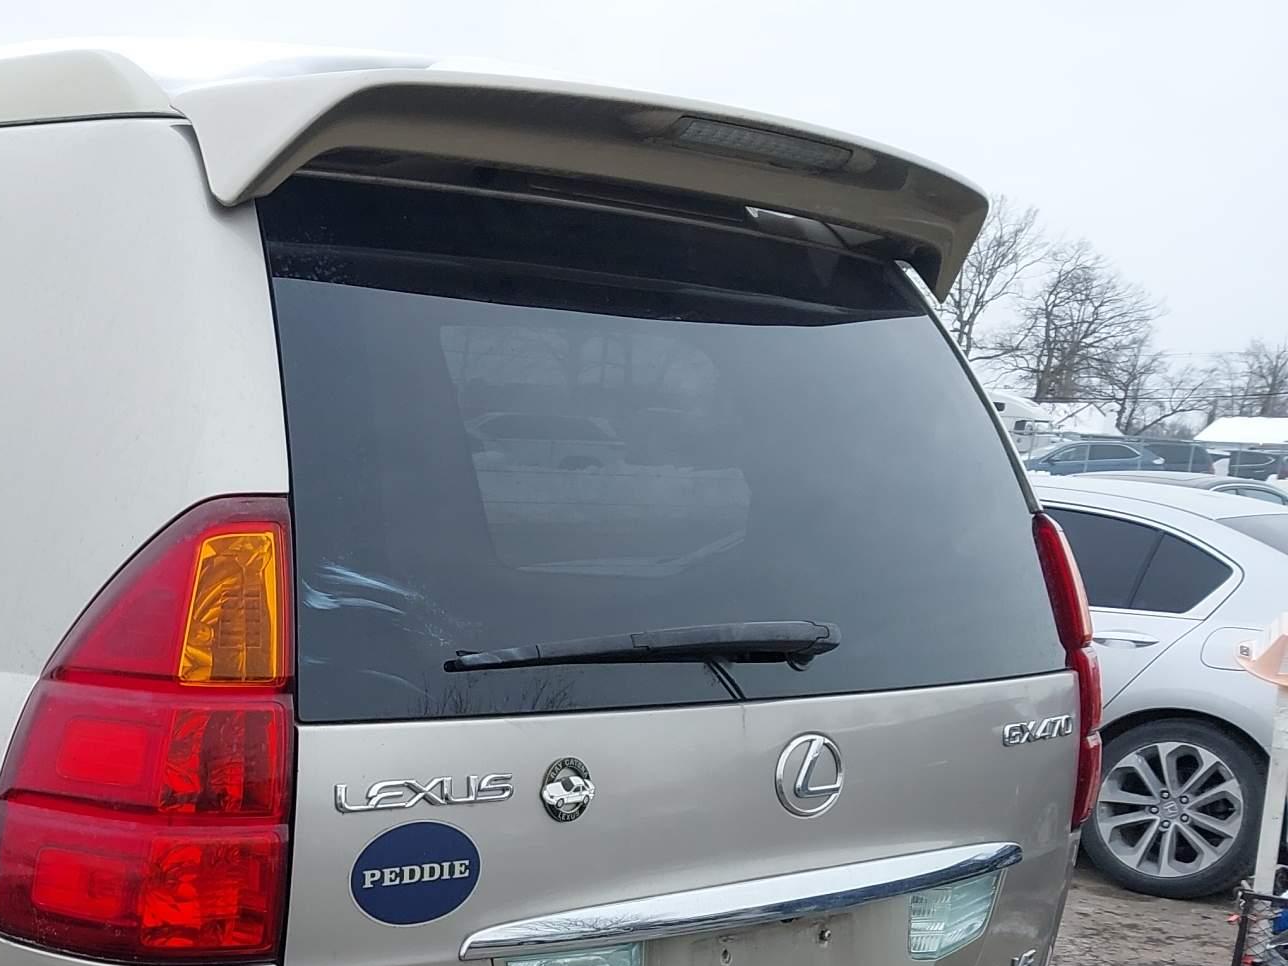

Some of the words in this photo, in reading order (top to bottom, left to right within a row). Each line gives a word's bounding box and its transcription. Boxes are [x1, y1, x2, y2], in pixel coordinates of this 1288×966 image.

[1003, 715, 1073, 746] GX470
[334, 773, 514, 814] LEXUS
[558, 810, 581, 821] LEXUS
[362, 859, 470, 889] PEDDIE
